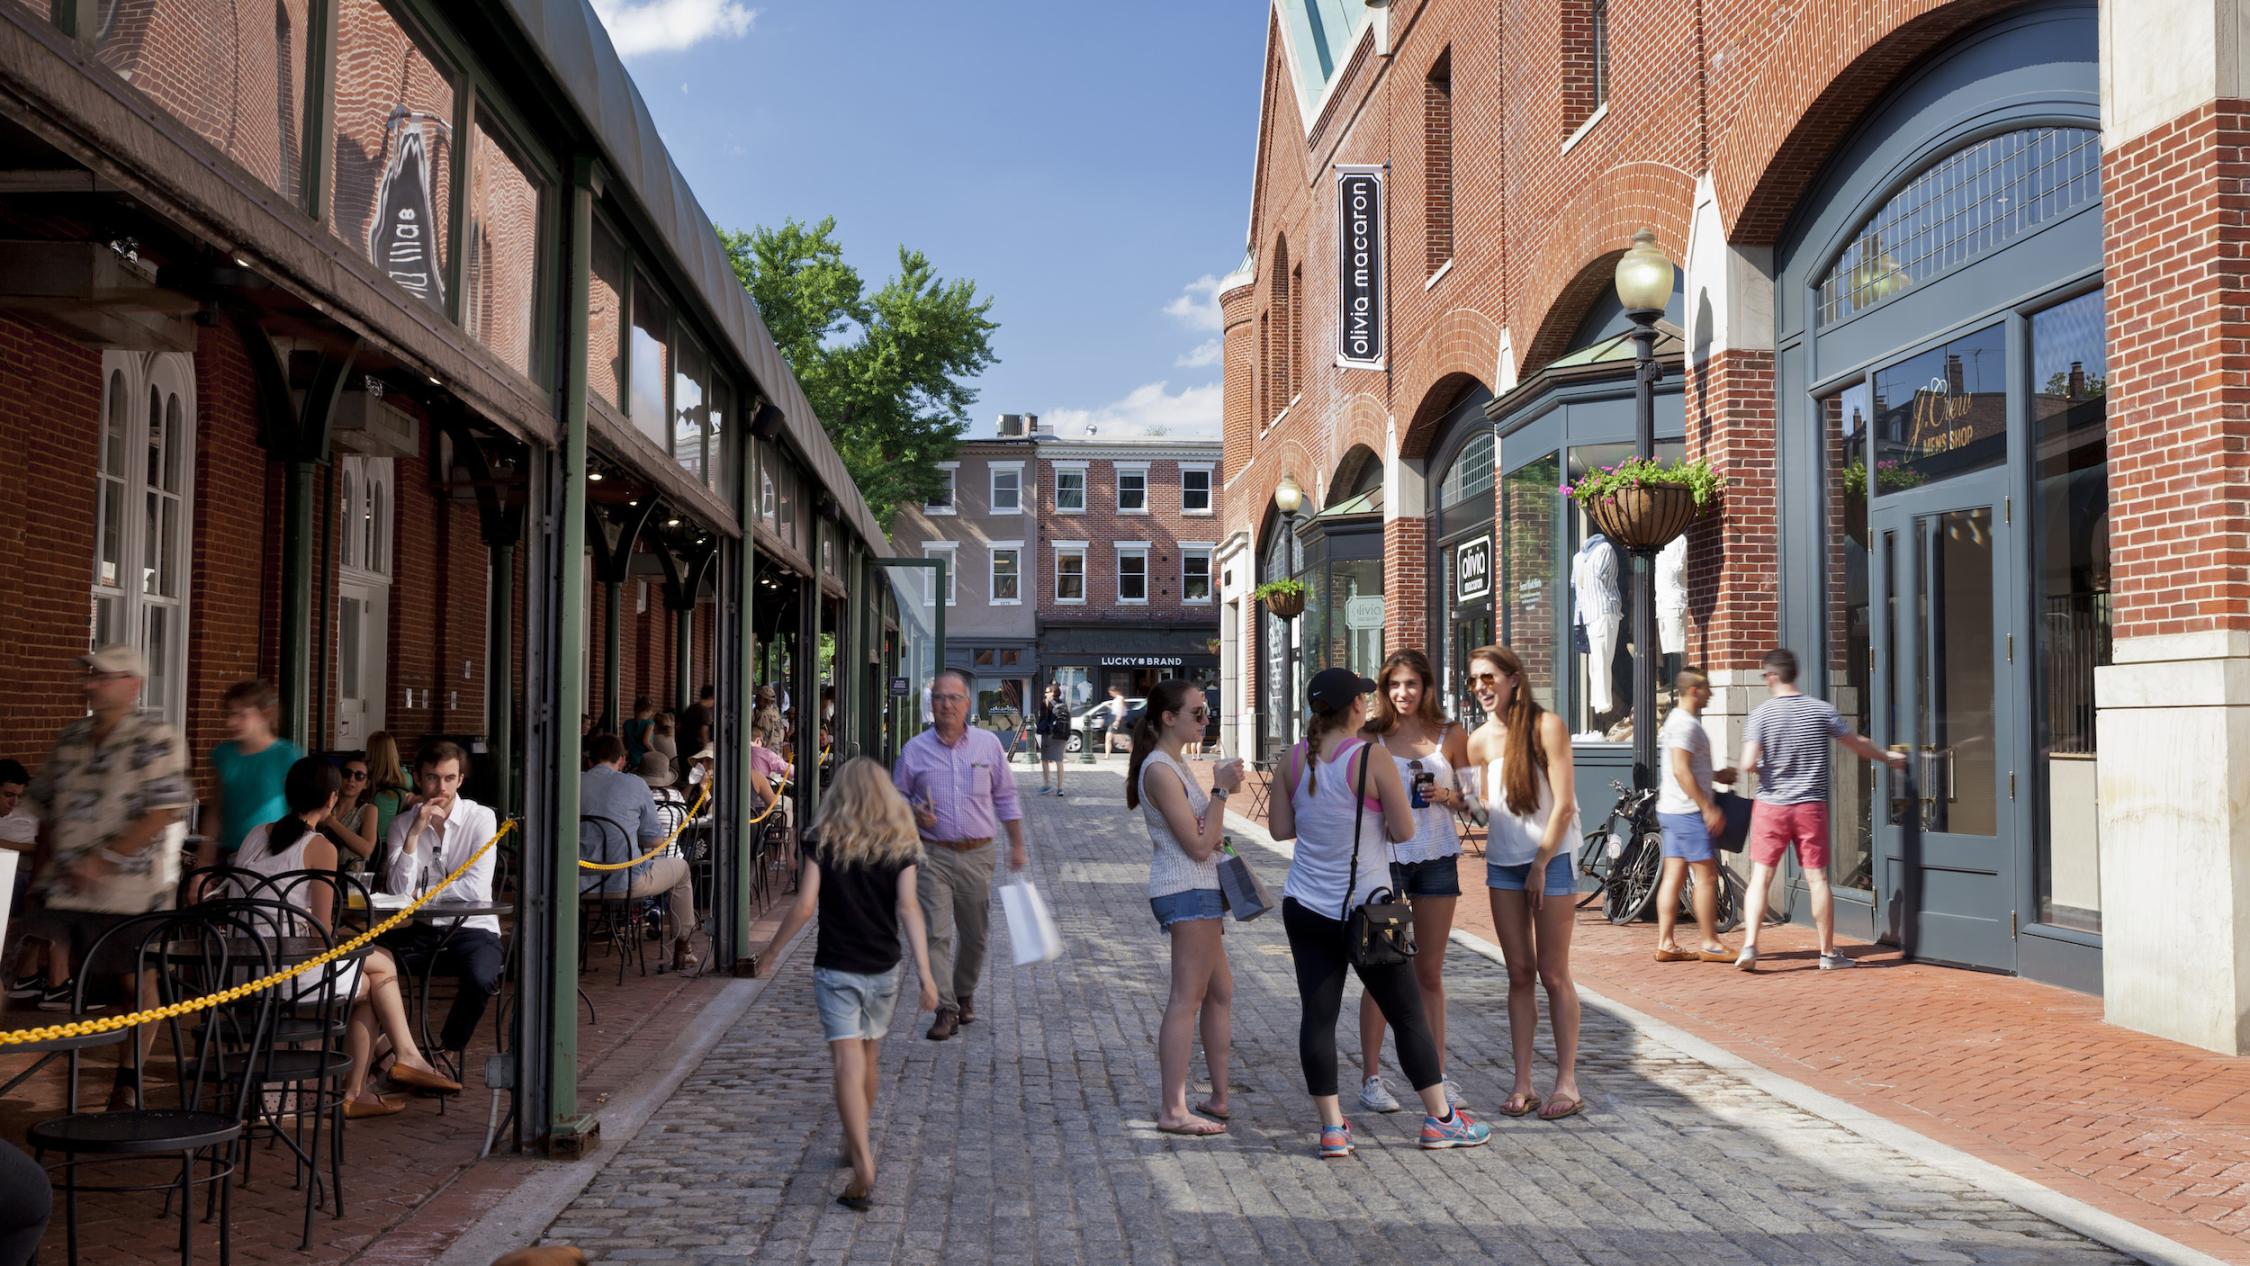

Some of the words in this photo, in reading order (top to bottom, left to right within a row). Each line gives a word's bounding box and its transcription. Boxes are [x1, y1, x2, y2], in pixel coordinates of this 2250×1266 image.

[1354, 183, 1368, 287] macaron
[1350, 298, 1368, 354] olivia
[1949, 425, 1973, 449] SHOP
[1463, 547, 1485, 579] olivia
[1101, 657, 1137, 666] LUCKY
[1146, 657, 1183, 666] BRAND
